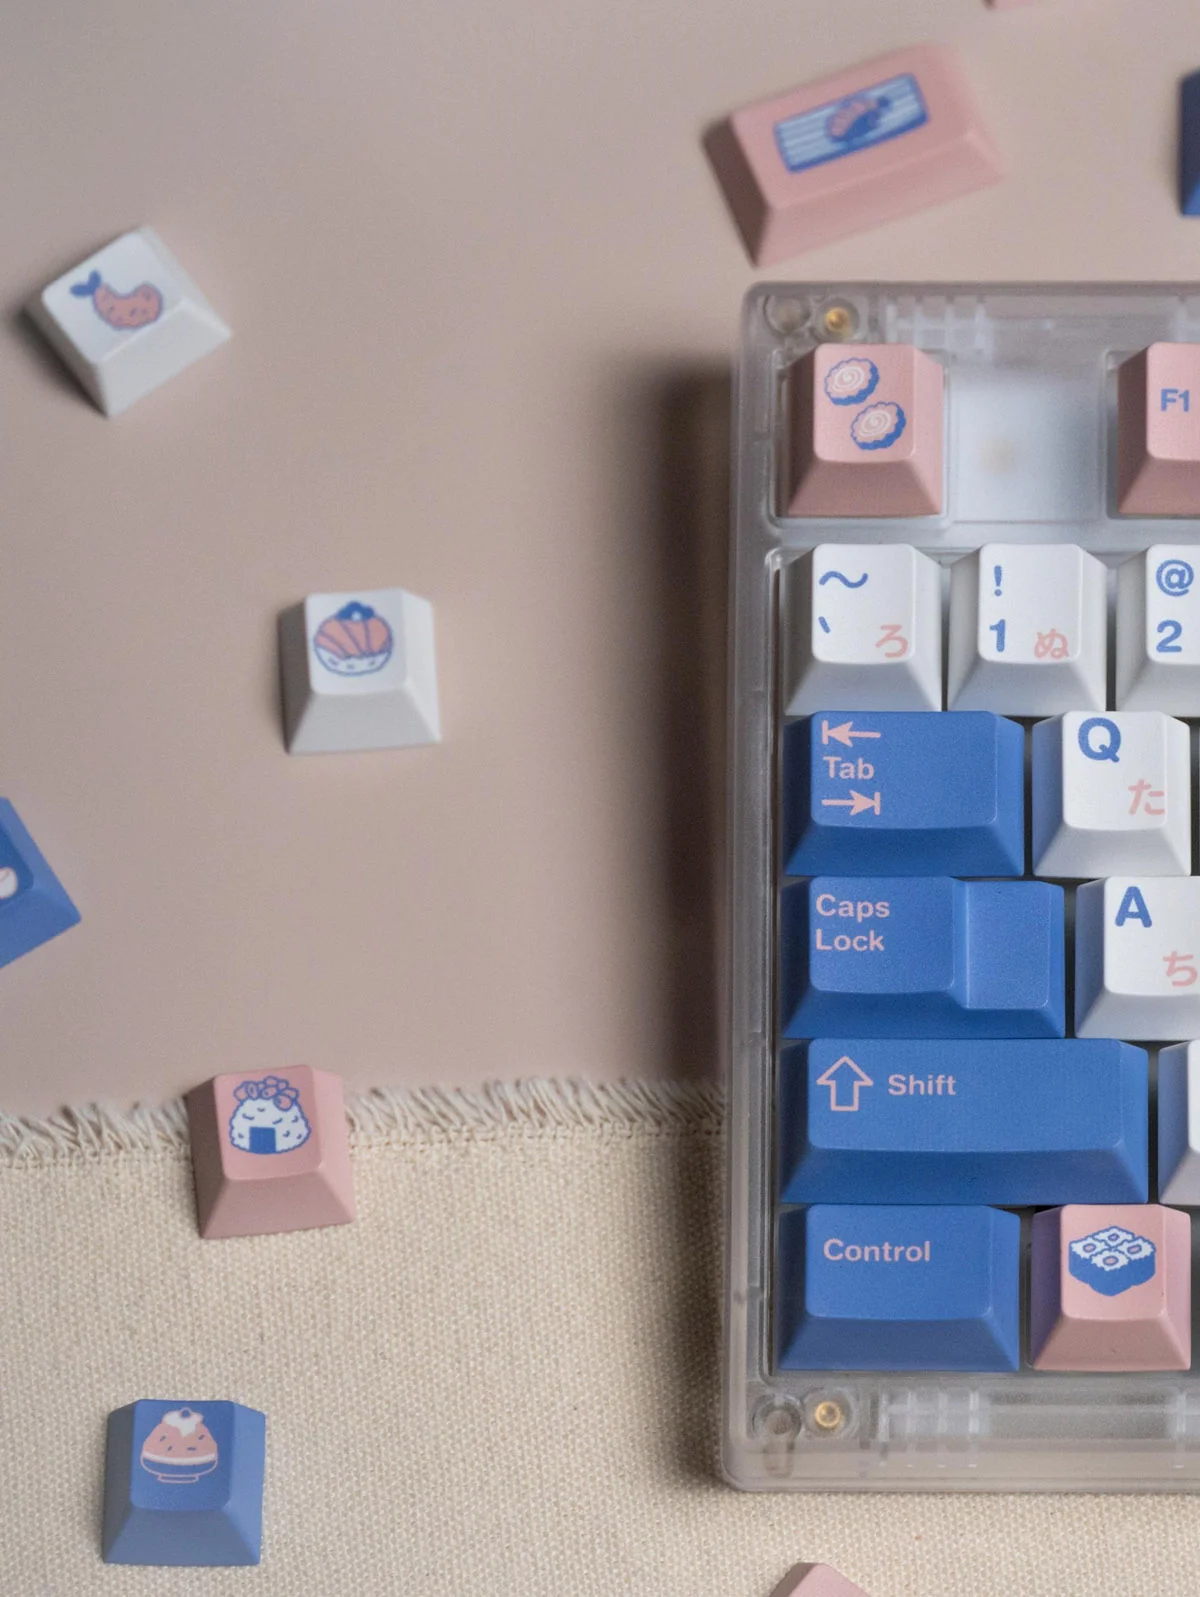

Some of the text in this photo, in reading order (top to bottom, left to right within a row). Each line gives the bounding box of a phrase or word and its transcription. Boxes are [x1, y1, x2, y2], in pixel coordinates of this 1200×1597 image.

[1161, 388, 1190, 412] F1
[994, 565, 1002, 596] !
[1156, 559, 1194, 597] @
[876, 623, 908, 658] ろ
[990, 620, 1006, 652] 1
[1034, 628, 1068, 660] ぬ
[1156, 620, 1182, 653] 2
[1079, 718, 1121, 762] Q
[823, 756, 874, 779] Tab
[1128, 780, 1166, 815] た
[816, 893, 890, 922] Caps
[1116, 887, 1151, 927] A
[816, 928, 884, 951] Lock
[1163, 952, 1197, 987] ち
[888, 1074, 955, 1095] Shift
[823, 1238, 930, 1262] Control
